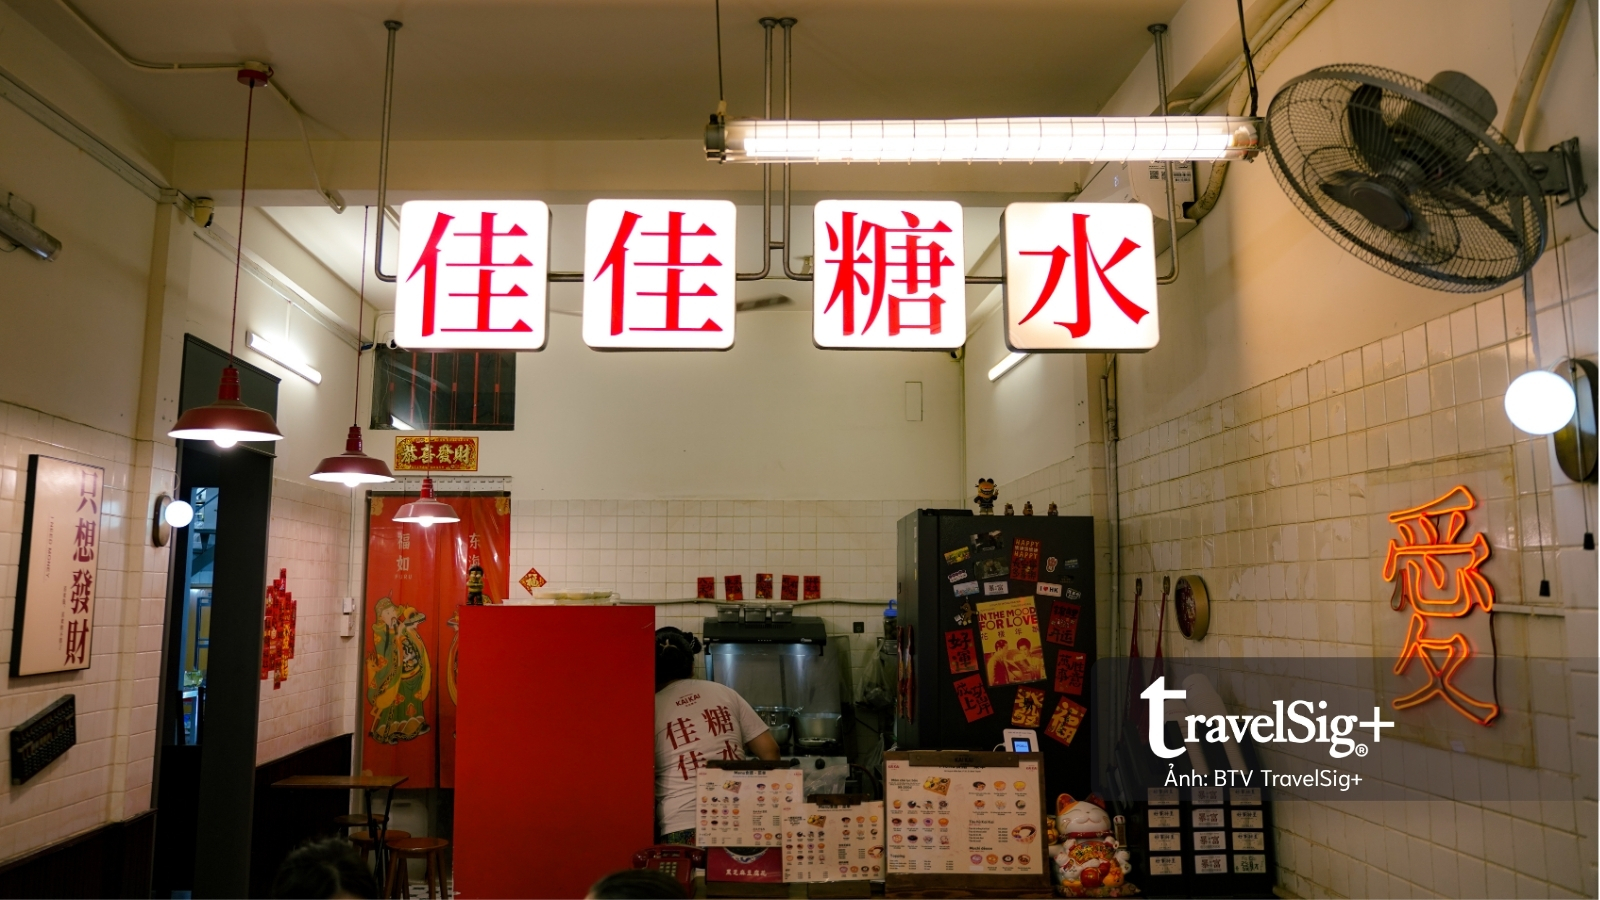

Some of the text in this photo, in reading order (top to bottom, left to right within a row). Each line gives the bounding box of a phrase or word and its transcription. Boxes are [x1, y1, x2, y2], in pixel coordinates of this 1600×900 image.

[401, 443, 471, 464] 恭喜發財
[45, 546, 53, 579] MONEY
[396, 533, 411, 572] 福如
[64, 469, 98, 667] 只想發財
[978, 606, 1036, 621] IN THE MOOD
[979, 614, 1038, 631] FOR LOVE
[675, 693, 701, 706] KAI KAI
